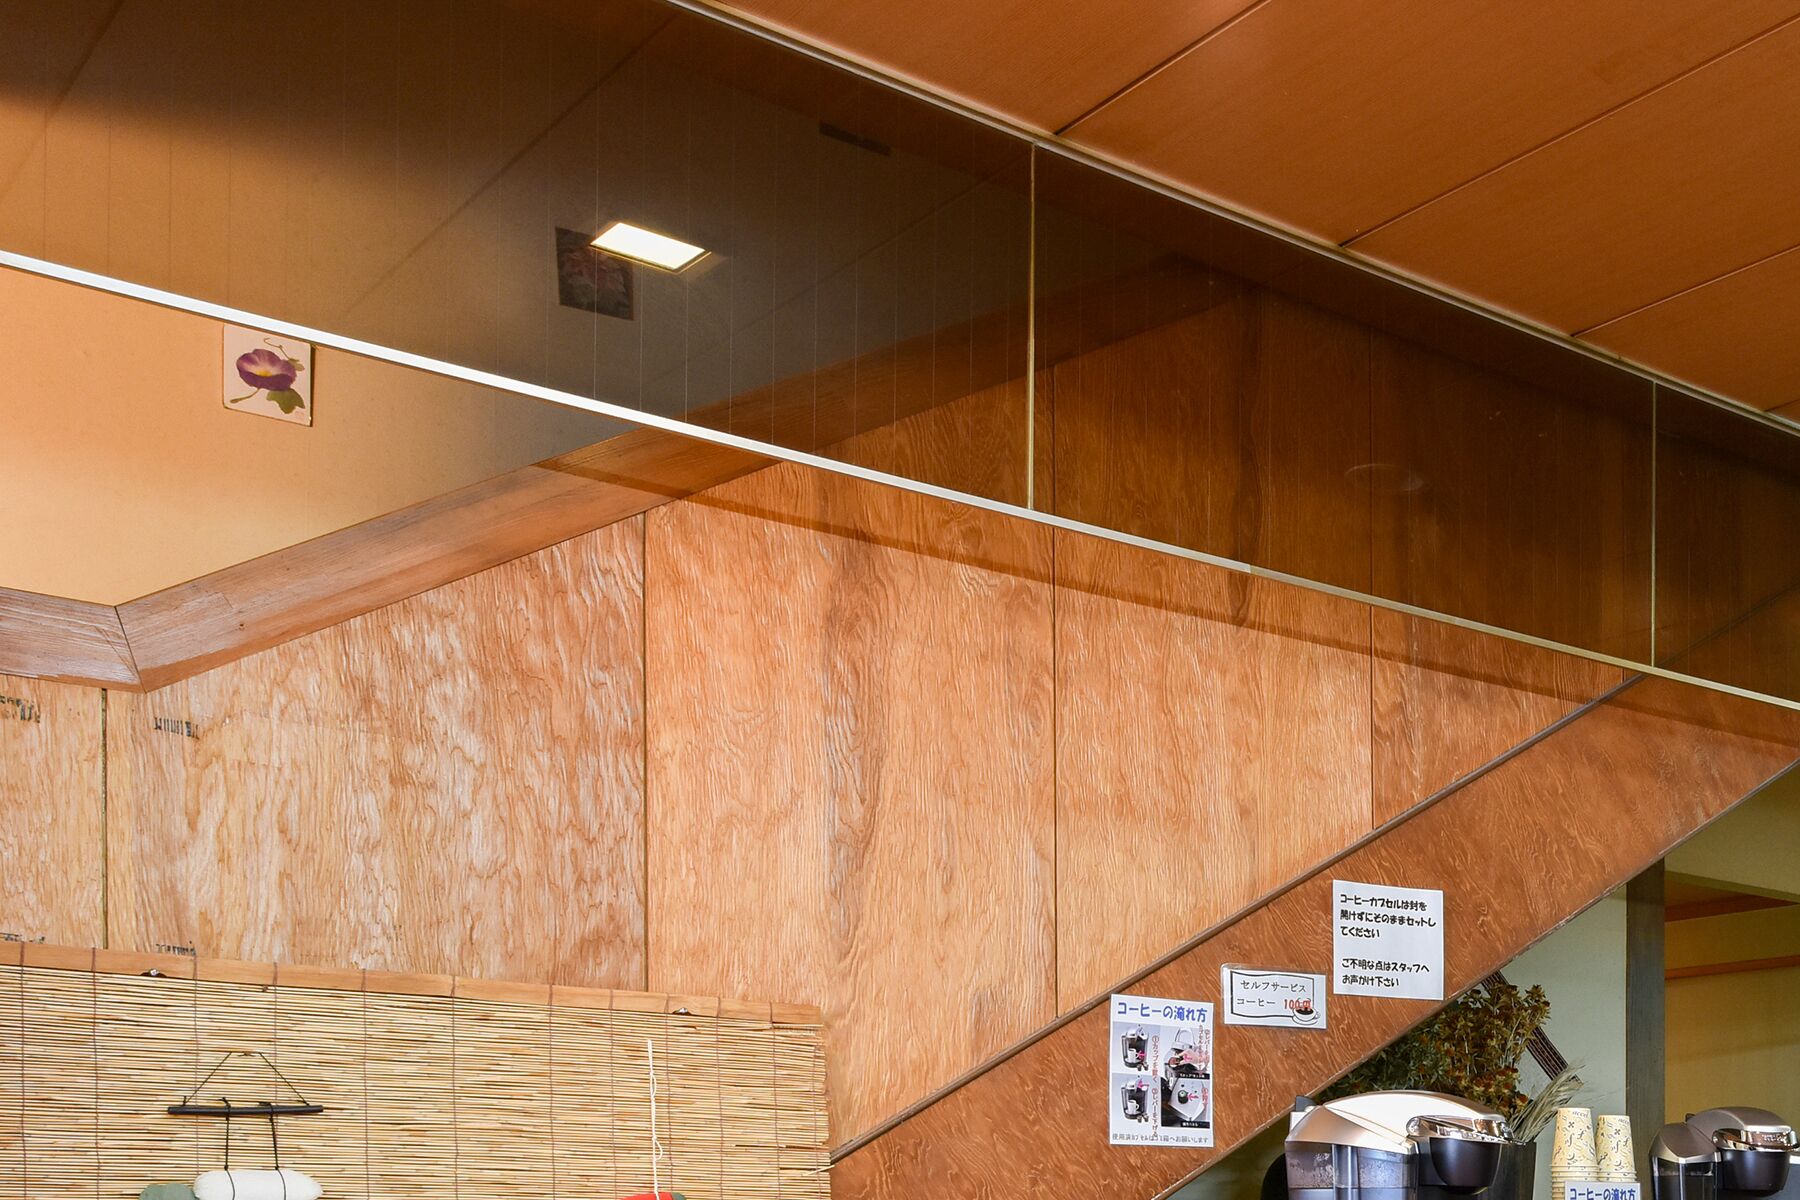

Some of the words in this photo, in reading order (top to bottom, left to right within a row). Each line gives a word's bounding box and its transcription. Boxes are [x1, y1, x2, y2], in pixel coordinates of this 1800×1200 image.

[1340, 894, 1427, 912] コーヒーカプセルは封を
[1340, 909, 1436, 928] 開けずにそのままセットし
[1340, 925, 1380, 938] てください
[1341, 958, 1430, 973] ご不明な点はスタッフへ
[1240, 979, 1306, 993] セルフサービス
[1342, 974, 1400, 987] お声がけ下さい
[1236, 997, 1275, 1007] コーヒー
[1117, 1002, 1208, 1023] コーヒーの淹れ方
